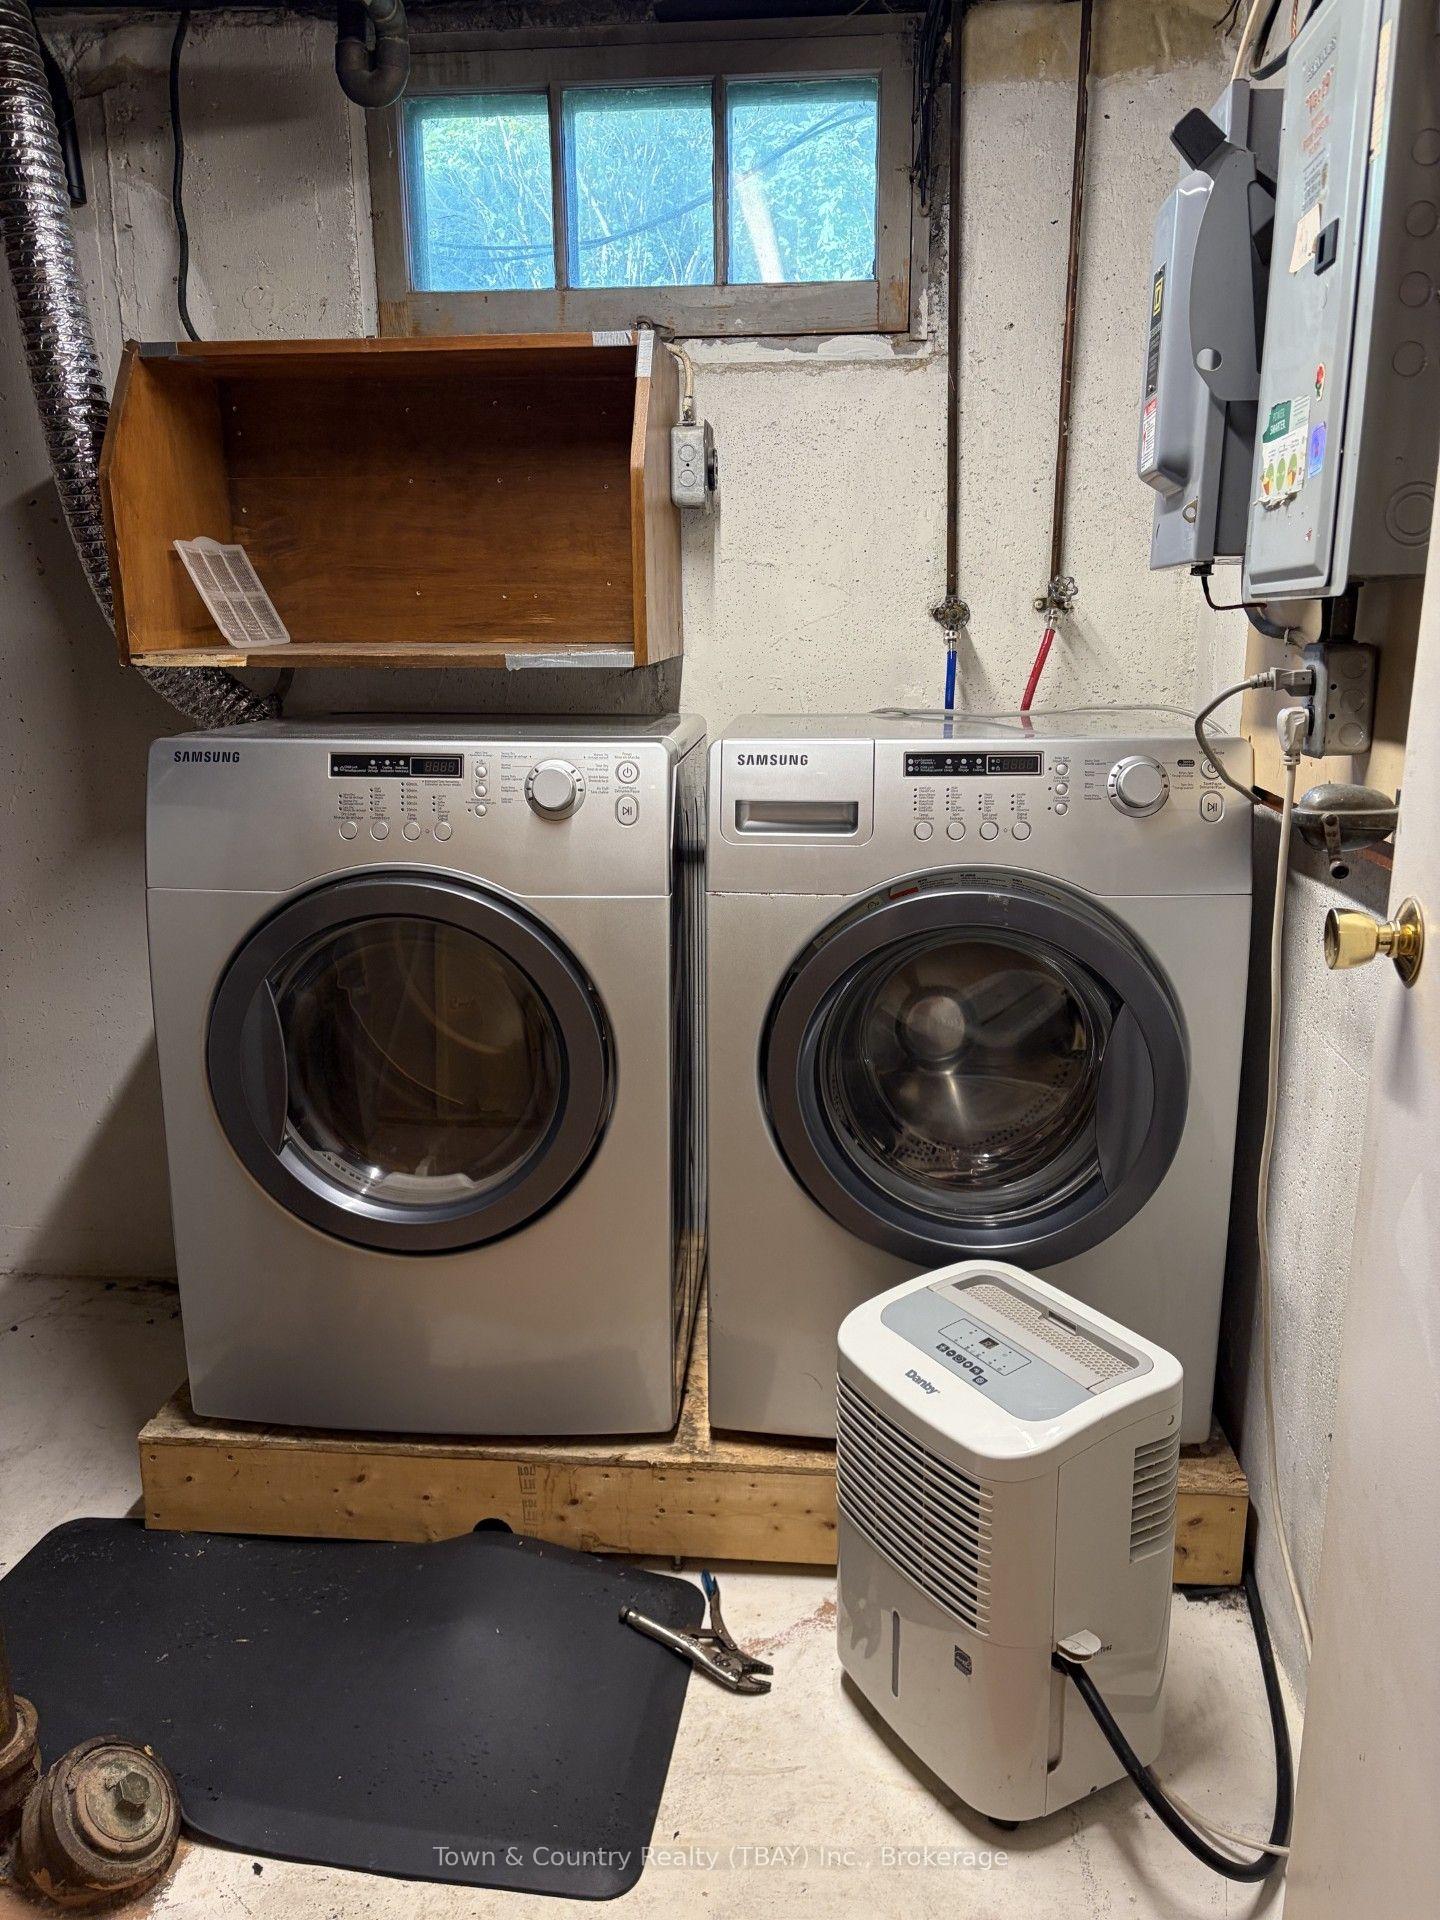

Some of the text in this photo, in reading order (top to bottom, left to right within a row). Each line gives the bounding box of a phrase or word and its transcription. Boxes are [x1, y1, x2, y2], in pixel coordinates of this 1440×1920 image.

[173, 750, 240, 763] SAMSUNG
[737, 754, 809, 766] SAMSUNG
[904, 1368, 939, 1395] Danby
